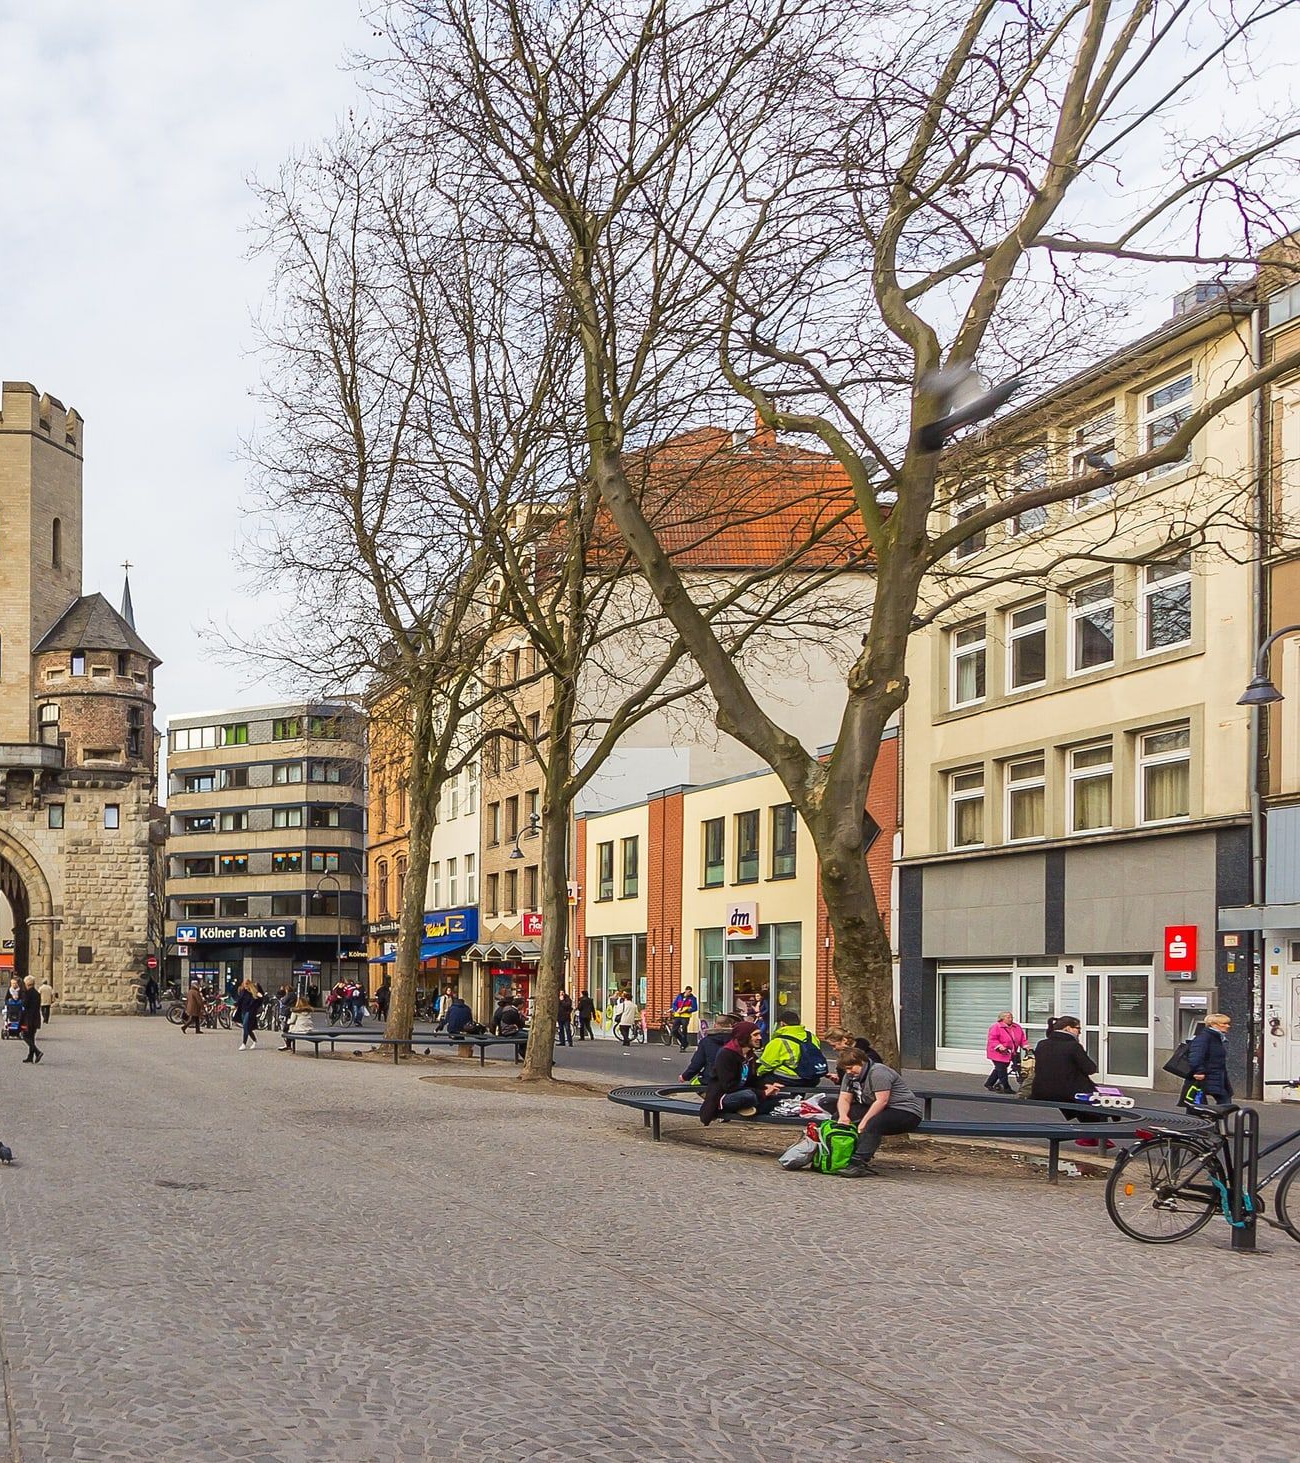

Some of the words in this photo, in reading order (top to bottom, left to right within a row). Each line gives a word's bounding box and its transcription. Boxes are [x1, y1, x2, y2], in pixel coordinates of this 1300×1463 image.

[731, 908, 750, 926] dm
[200, 926, 236, 939] Kölner
[239, 926, 267, 938] Bank
[269, 926, 286, 938] eG
